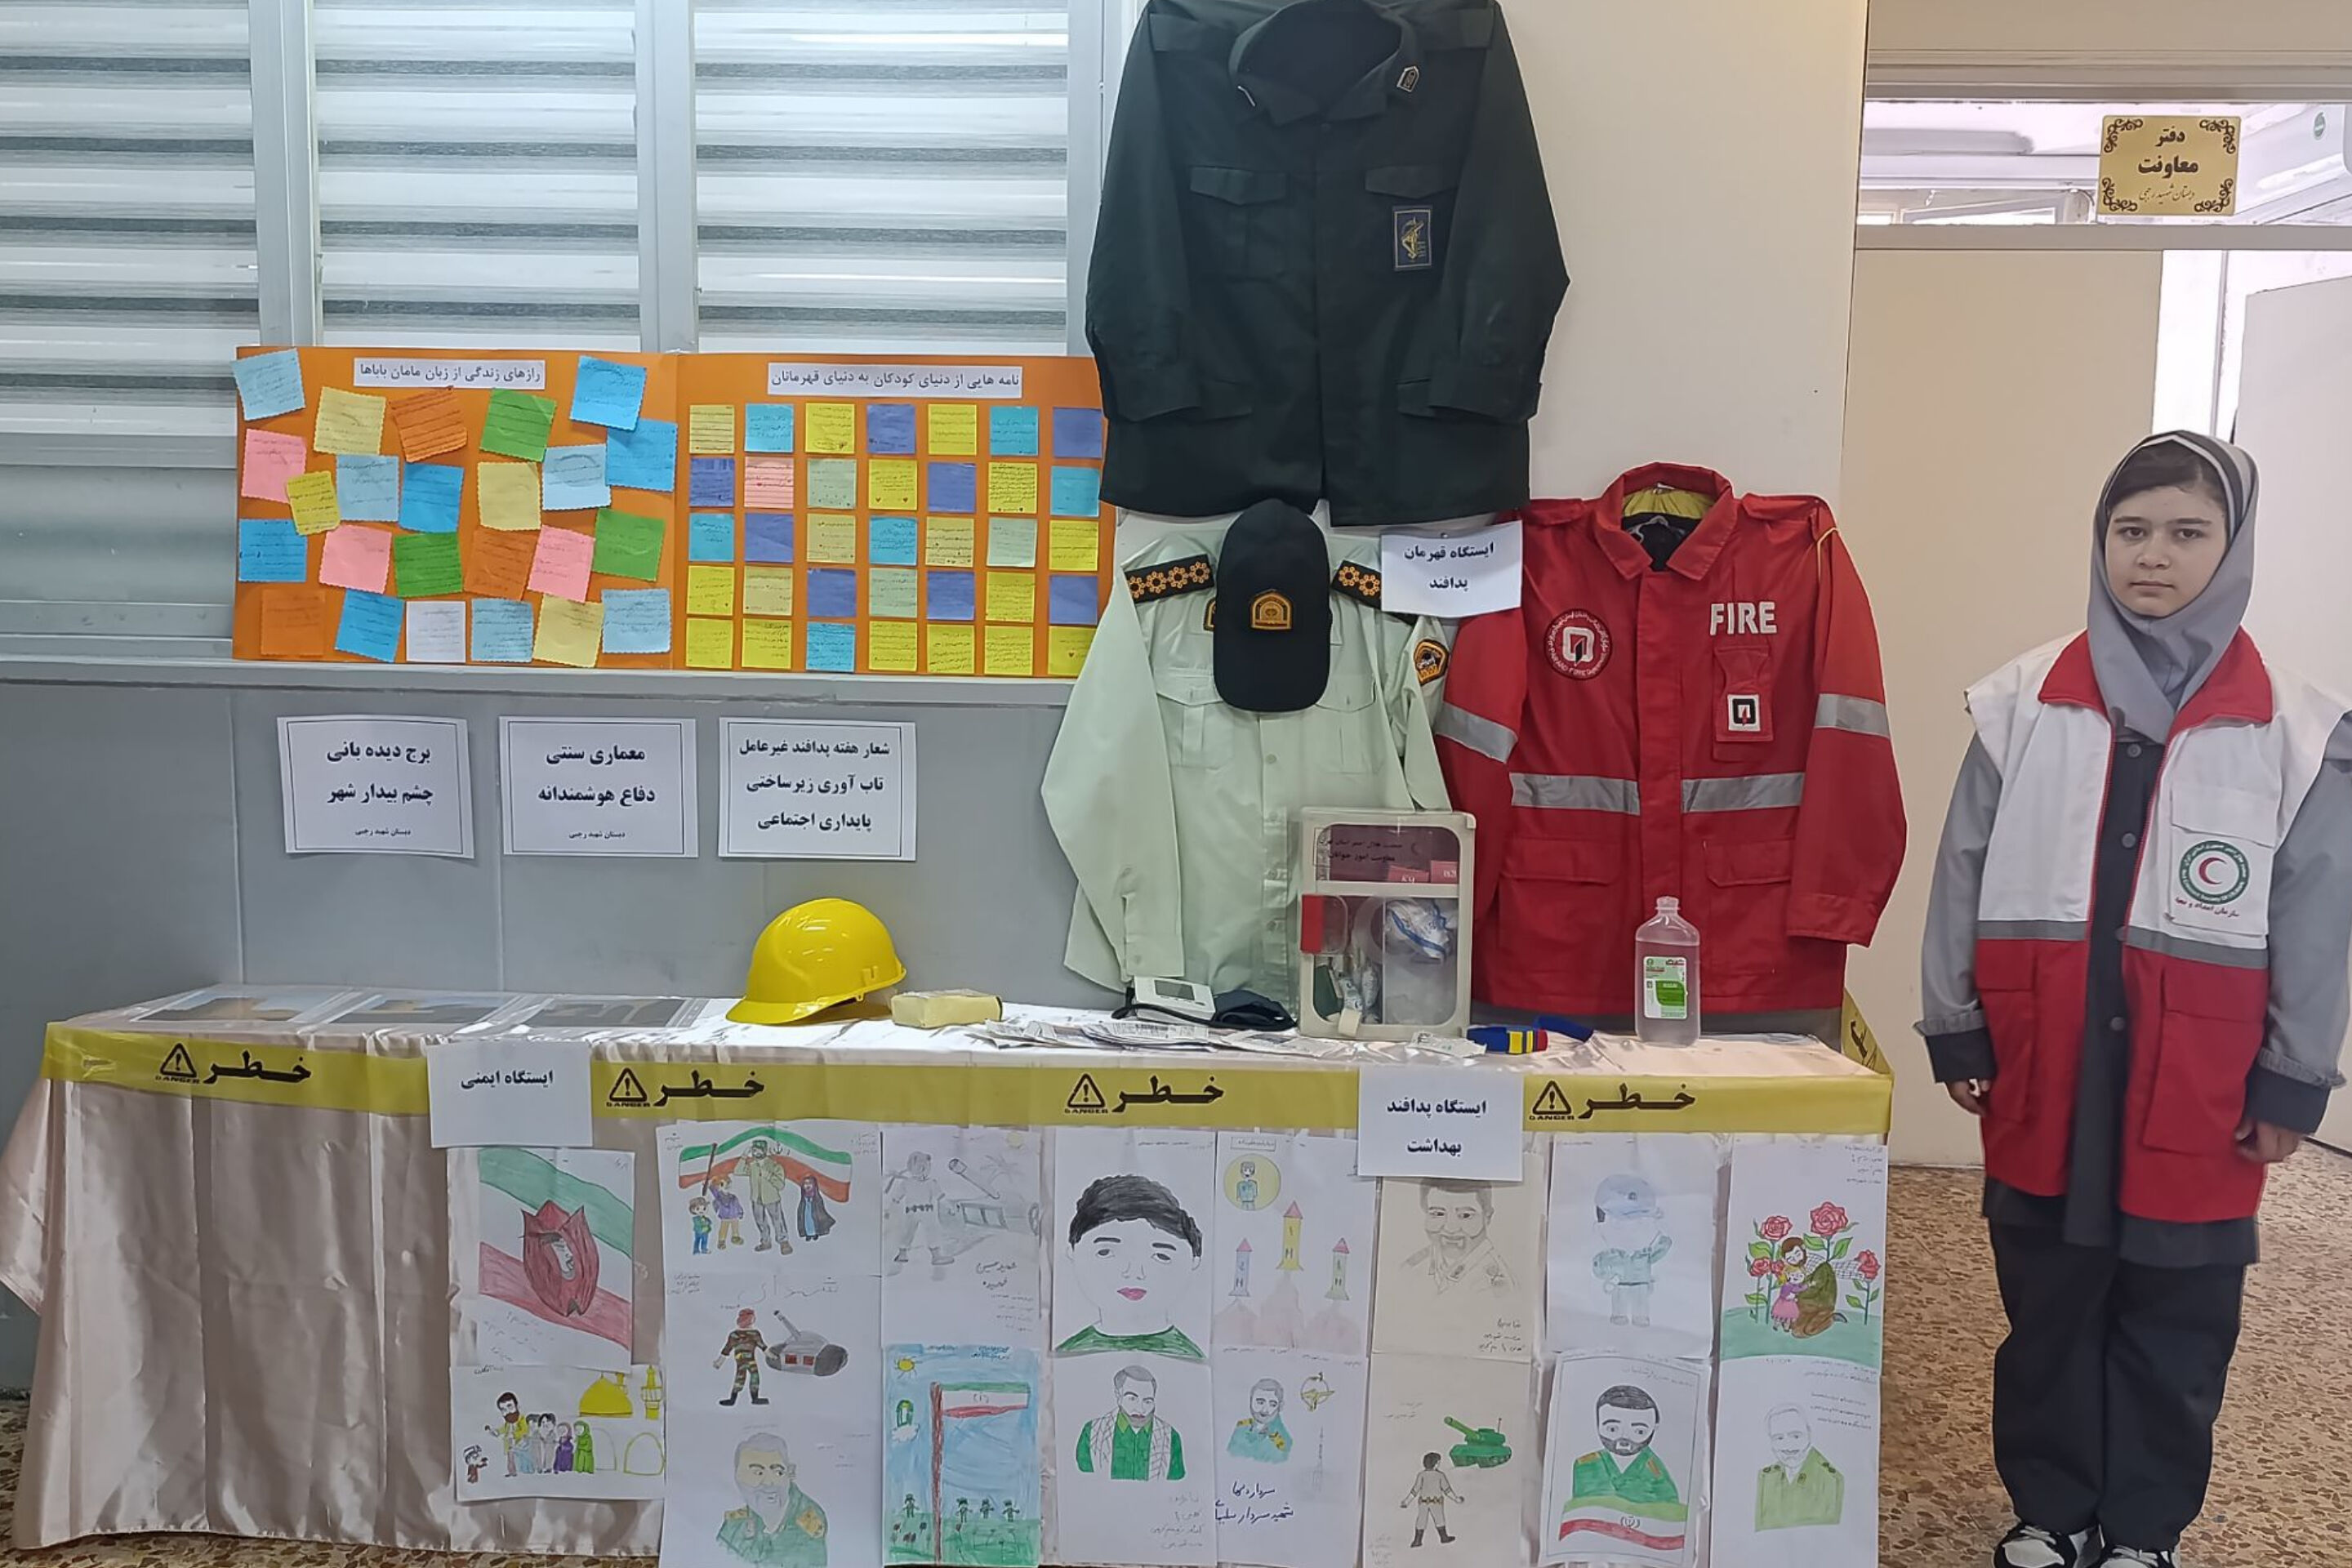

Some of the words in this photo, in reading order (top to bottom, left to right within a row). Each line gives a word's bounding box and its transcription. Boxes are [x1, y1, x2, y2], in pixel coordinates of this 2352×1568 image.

[2154, 126, 2185, 147] دفتر
[2138, 155, 2198, 179] معاونت
[2155, 183, 2174, 204] شهید
[2172, 185, 2195, 202] دبستان
[360, 363, 387, 379] باباها
[391, 363, 421, 380] مامان
[425, 364, 449, 381] زبان
[452, 367, 461, 381] از
[466, 365, 500, 382] زندگی
[503, 367, 541, 382] رازهای
[772, 370, 819, 385] قهرمانان
[823, 372, 854, 385] دنیای
[858, 374, 869, 385] به
[874, 372, 915, 388] کودکان
[999, 373, 1019, 386] نامه
[919, 372, 951, 389] دنیای
[953, 373, 964, 389] از
[967, 373, 994, 390] هایی
[1404, 545, 1446, 562] قهرمان
[1450, 541, 1494, 559] ایستگاه
[1429, 576, 1468, 592] پدافند
[1709, 601, 1777, 635] FIRE
[327, 741, 360, 762] بانی
[366, 745, 401, 761] دیده
[406, 746, 430, 764] برج
[546, 746, 585, 764] سنتی
[590, 745, 645, 765] معماری
[792, 740, 830, 758] پدافند
[833, 742, 858, 755] هفته
[863, 742, 890, 759] شعار
[746, 774, 813, 794] زیرساختی
[818, 774, 856, 795] آوری
[860, 777, 884, 795] تاب
[327, 783, 356, 804] شهر
[361, 783, 397, 804] بیدار
[402, 785, 434, 806] چشم
[537, 785, 614, 807] هوشمندانه
[619, 786, 655, 807] دفاع
[758, 812, 815, 831] اجتماعی
[819, 813, 871, 832] پایداری
[203, 1050, 312, 1085] خطر
[155, 1076, 200, 1085] DANGER
[461, 1071, 500, 1089] ایمنی
[505, 1070, 554, 1088] ایستگاه
[653, 1070, 765, 1107] خطر
[1111, 1075, 1224, 1113] خطر
[1387, 1097, 1431, 1119] پدافند
[1436, 1099, 1486, 1118] ایستگاه
[1578, 1082, 1696, 1119] خطر
[1406, 1138, 1462, 1157] بهداشت
